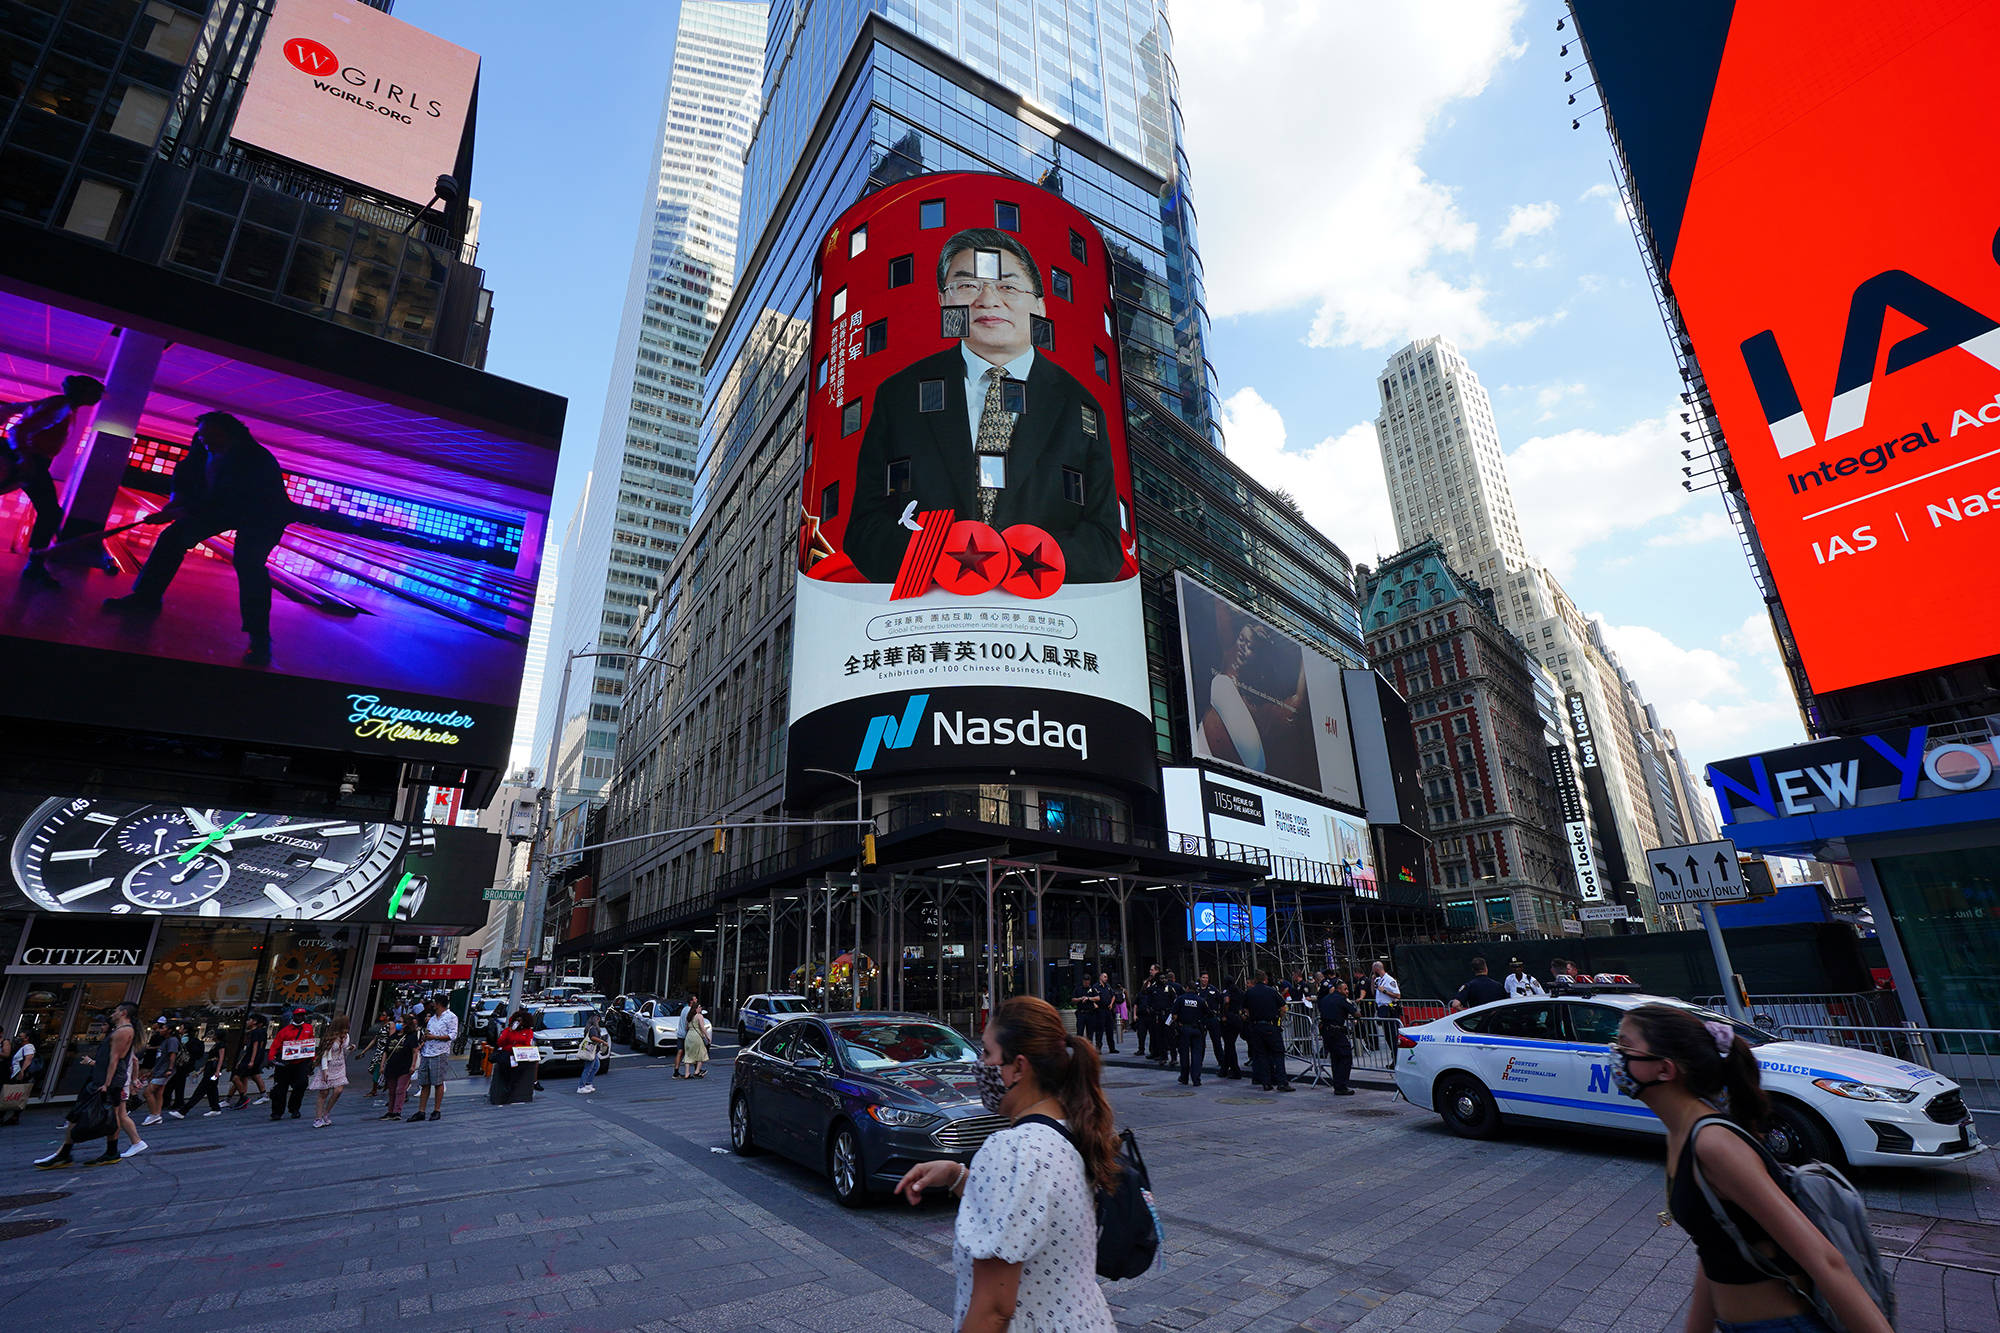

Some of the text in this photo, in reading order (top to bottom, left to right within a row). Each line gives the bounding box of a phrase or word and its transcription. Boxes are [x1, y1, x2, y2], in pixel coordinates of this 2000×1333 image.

[313, 79, 413, 125] WGIRLS.ORG
[341, 67, 442, 118] GIRLS
[847, 309, 863, 361] 周广军
[1740, 224, 2000, 459] IA
[1787, 422, 1940, 495] Integral
[1811, 525, 1878, 565] IAS
[888, 625, 909, 635] Global
[910, 623, 936, 632] Chinese
[1000, 621, 1013, 630] and
[1014, 621, 1029, 631] help
[844, 640, 1100, 676] 全球華商菁英100人風采展
[878, 667, 925, 680] Exhibition
[928, 665, 939, 674] of
[962, 664, 1001, 673] Chinese
[1004, 665, 1045, 675] Business
[1048, 668, 1072, 678] Elites
[346, 694, 475, 728] Gunpowder
[355, 718, 460, 744] Milkshake
[933, 710, 1088, 760] Nasdaq
[1570, 696, 1598, 768] Foot Locker
[1861, 725, 2000, 800] YO
[71, 798, 90, 812] 45
[1214, 791, 1233, 810] 1155
[1274, 809, 1308, 827] FRAME YOUR
[1276, 820, 1311, 838] FUTURE HERE
[261, 832, 323, 851] CITIZEN
[236, 863, 289, 879] Eco-Drive
[1572, 825, 1598, 898] Foot Locker
[151, 889, 171, 900] 30
[484, 890, 522, 900] BROADWAY
[1659, 890, 1682, 900] ONLY
[1686, 887, 1710, 898] ONLY
[1715, 885, 1741, 896] ONLY
[22, 947, 142, 966] CITIZEN
[1762, 1060, 1810, 1076] POLICE
